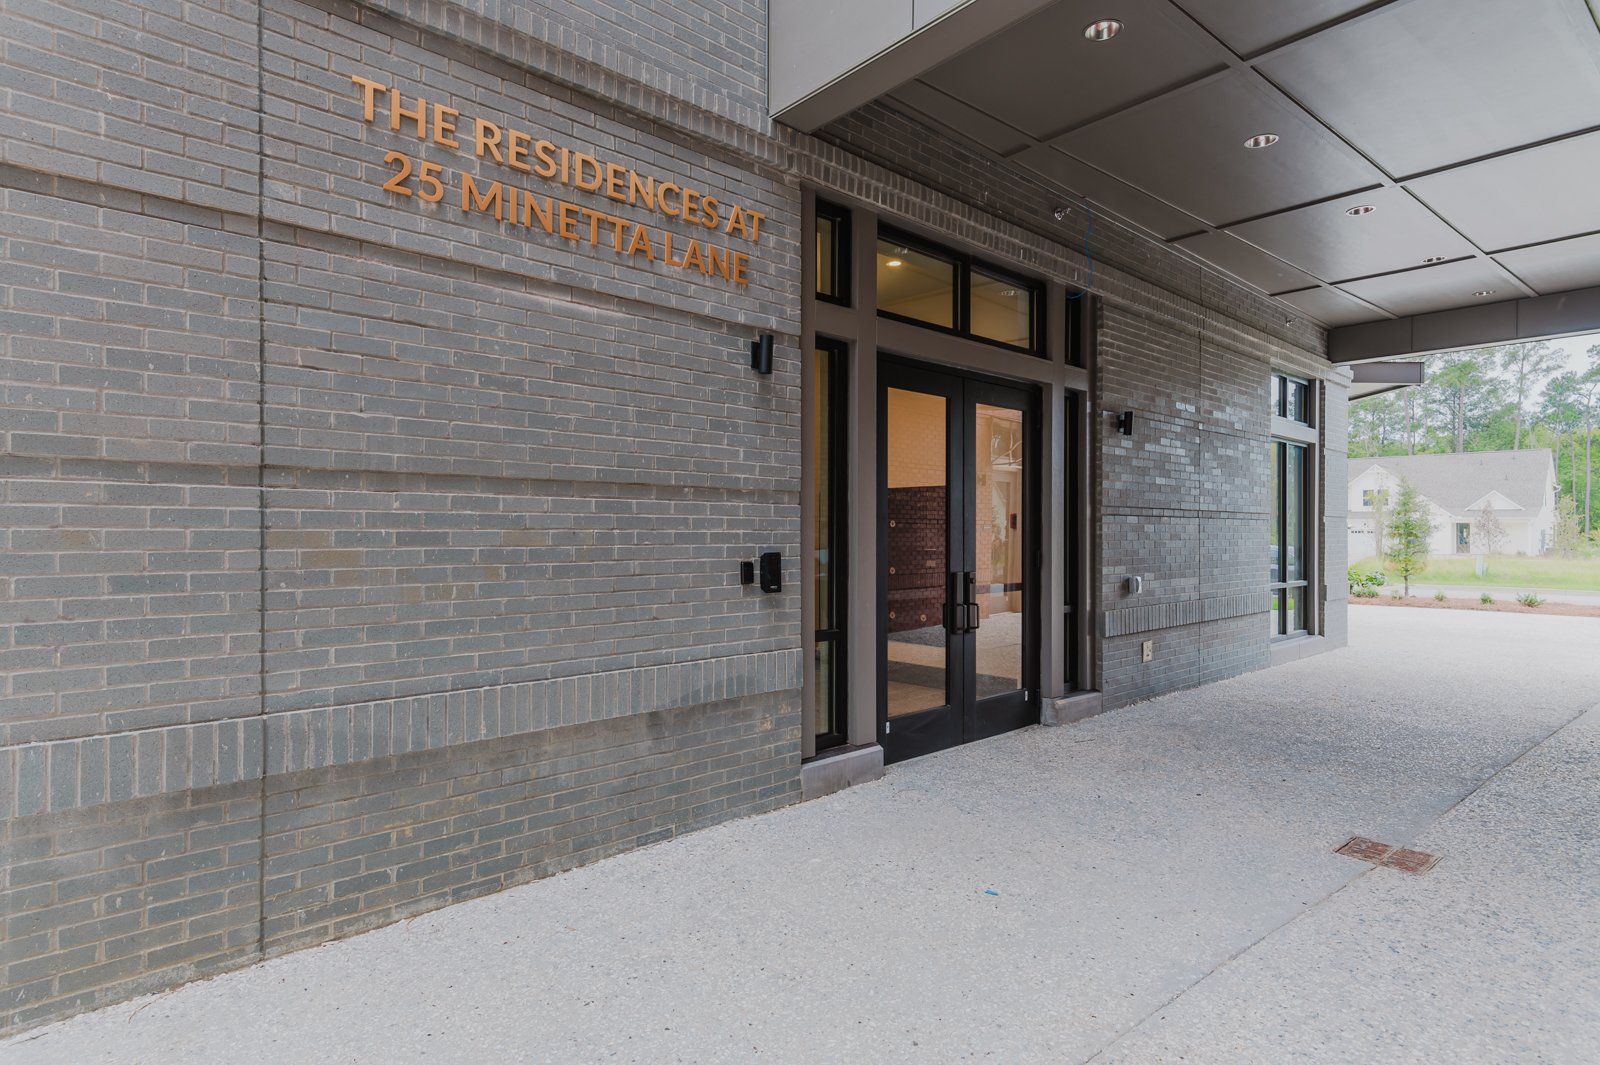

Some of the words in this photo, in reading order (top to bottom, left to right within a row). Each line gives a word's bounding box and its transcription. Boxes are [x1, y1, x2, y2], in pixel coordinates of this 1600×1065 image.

[351, 75, 461, 149] THE
[474, 117, 720, 230] RESIDENCES
[725, 204, 766, 242] AT
[382, 150, 445, 204] 25
[461, 171, 656, 262] MINETTA
[663, 230, 750, 286] LANE
